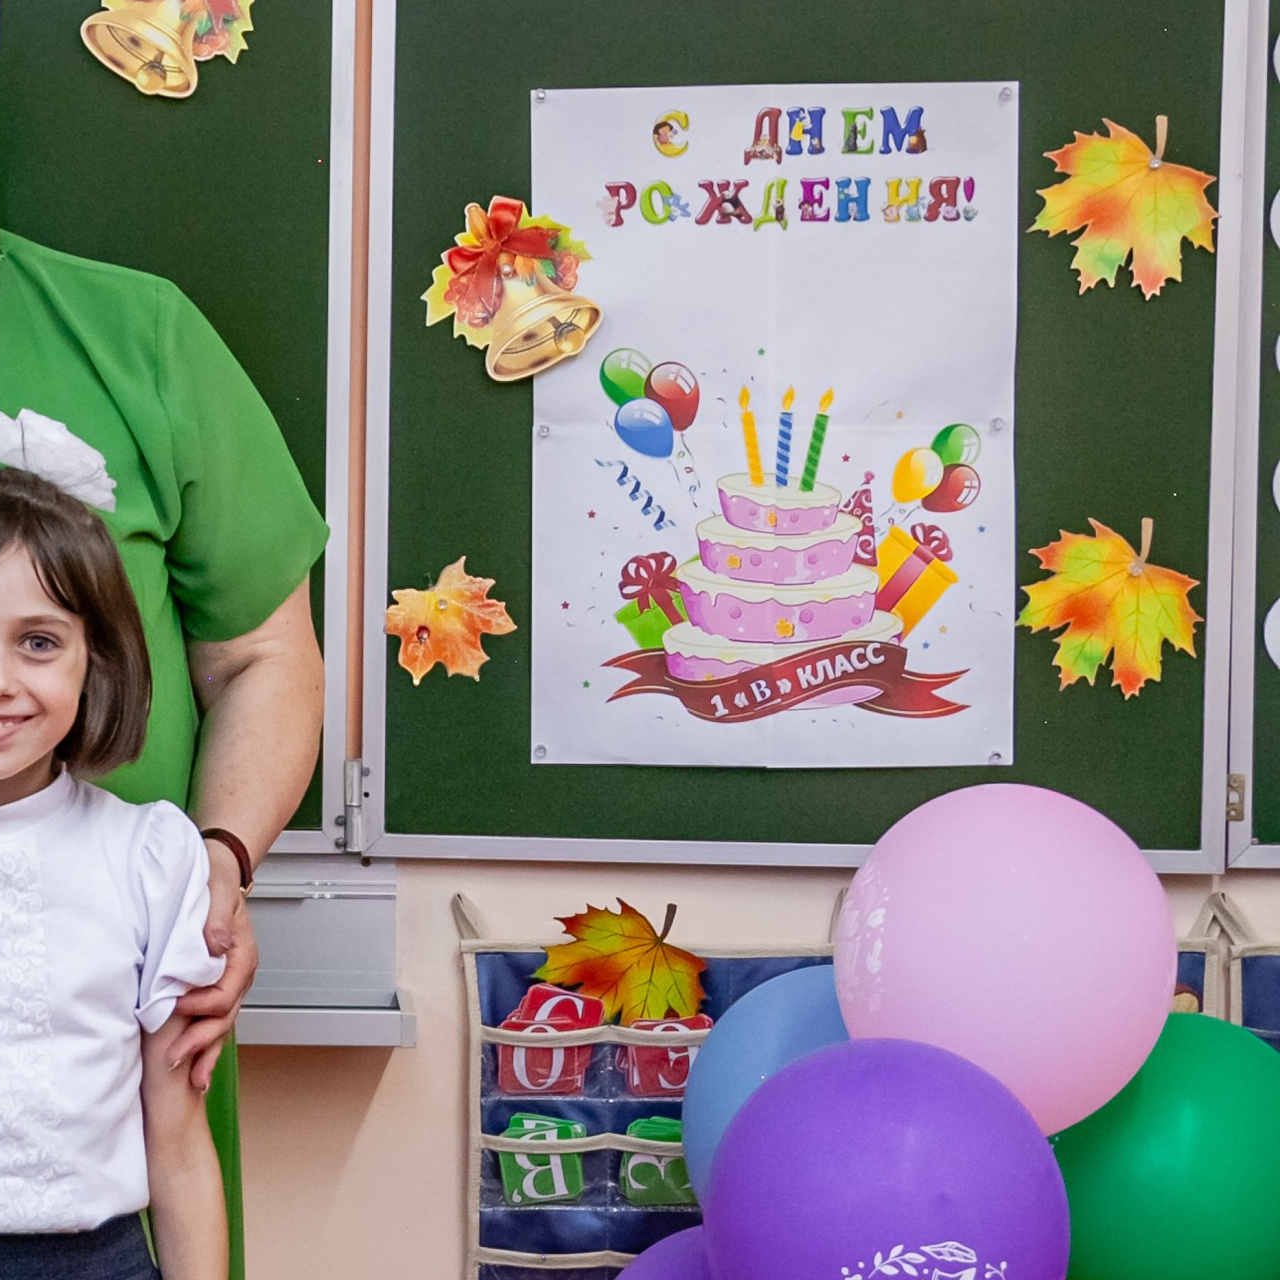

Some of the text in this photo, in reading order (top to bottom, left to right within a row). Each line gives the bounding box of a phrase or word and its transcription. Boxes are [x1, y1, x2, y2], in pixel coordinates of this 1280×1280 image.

[652, 106, 928, 165] С ДНЕМ
[598, 176, 978, 232] РОЖДЕНИЯ!
[710, 694, 729, 717] 1
[796, 642, 885, 689] КЛАСС
